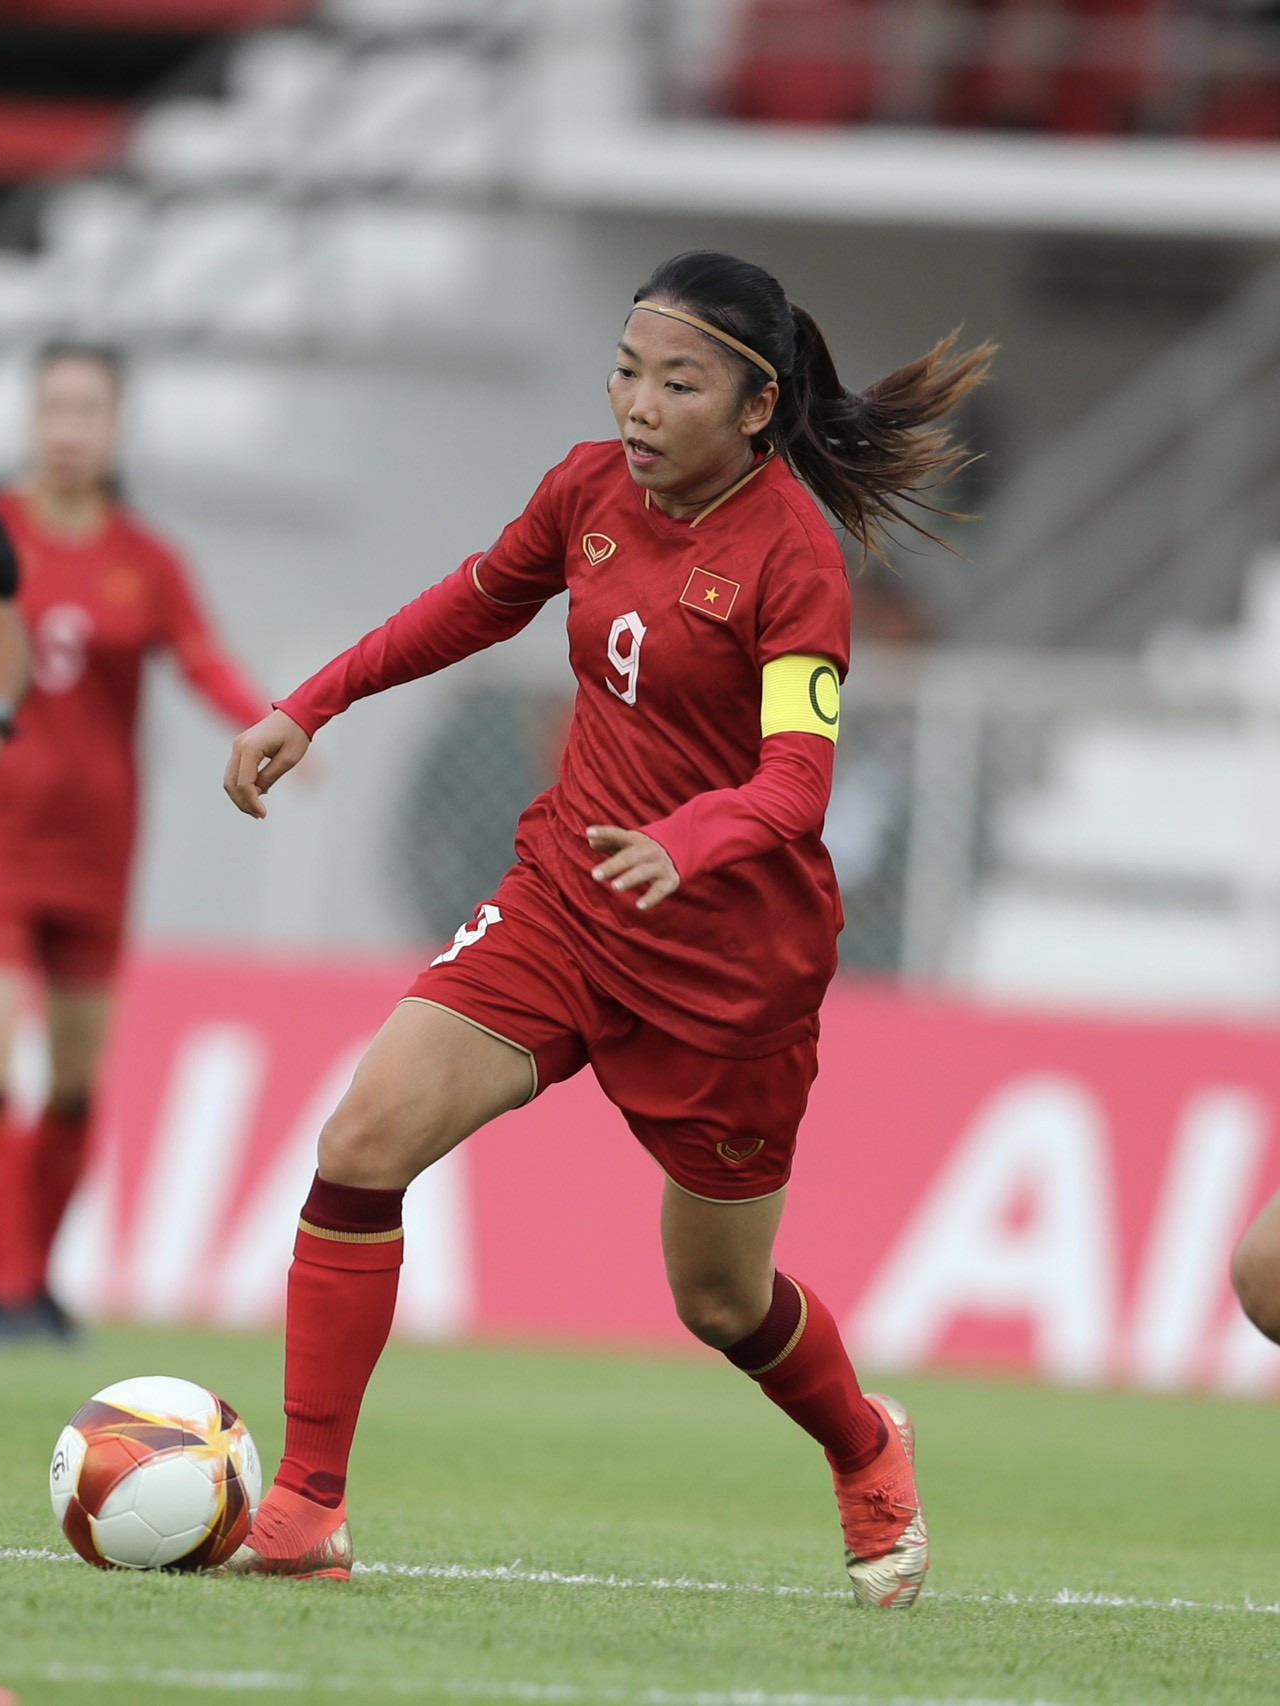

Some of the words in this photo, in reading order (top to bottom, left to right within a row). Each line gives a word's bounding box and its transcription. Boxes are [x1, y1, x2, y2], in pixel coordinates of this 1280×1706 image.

[605, 610, 648, 708] 9
[809, 666, 839, 725] C
[429, 903, 504, 968] 9
